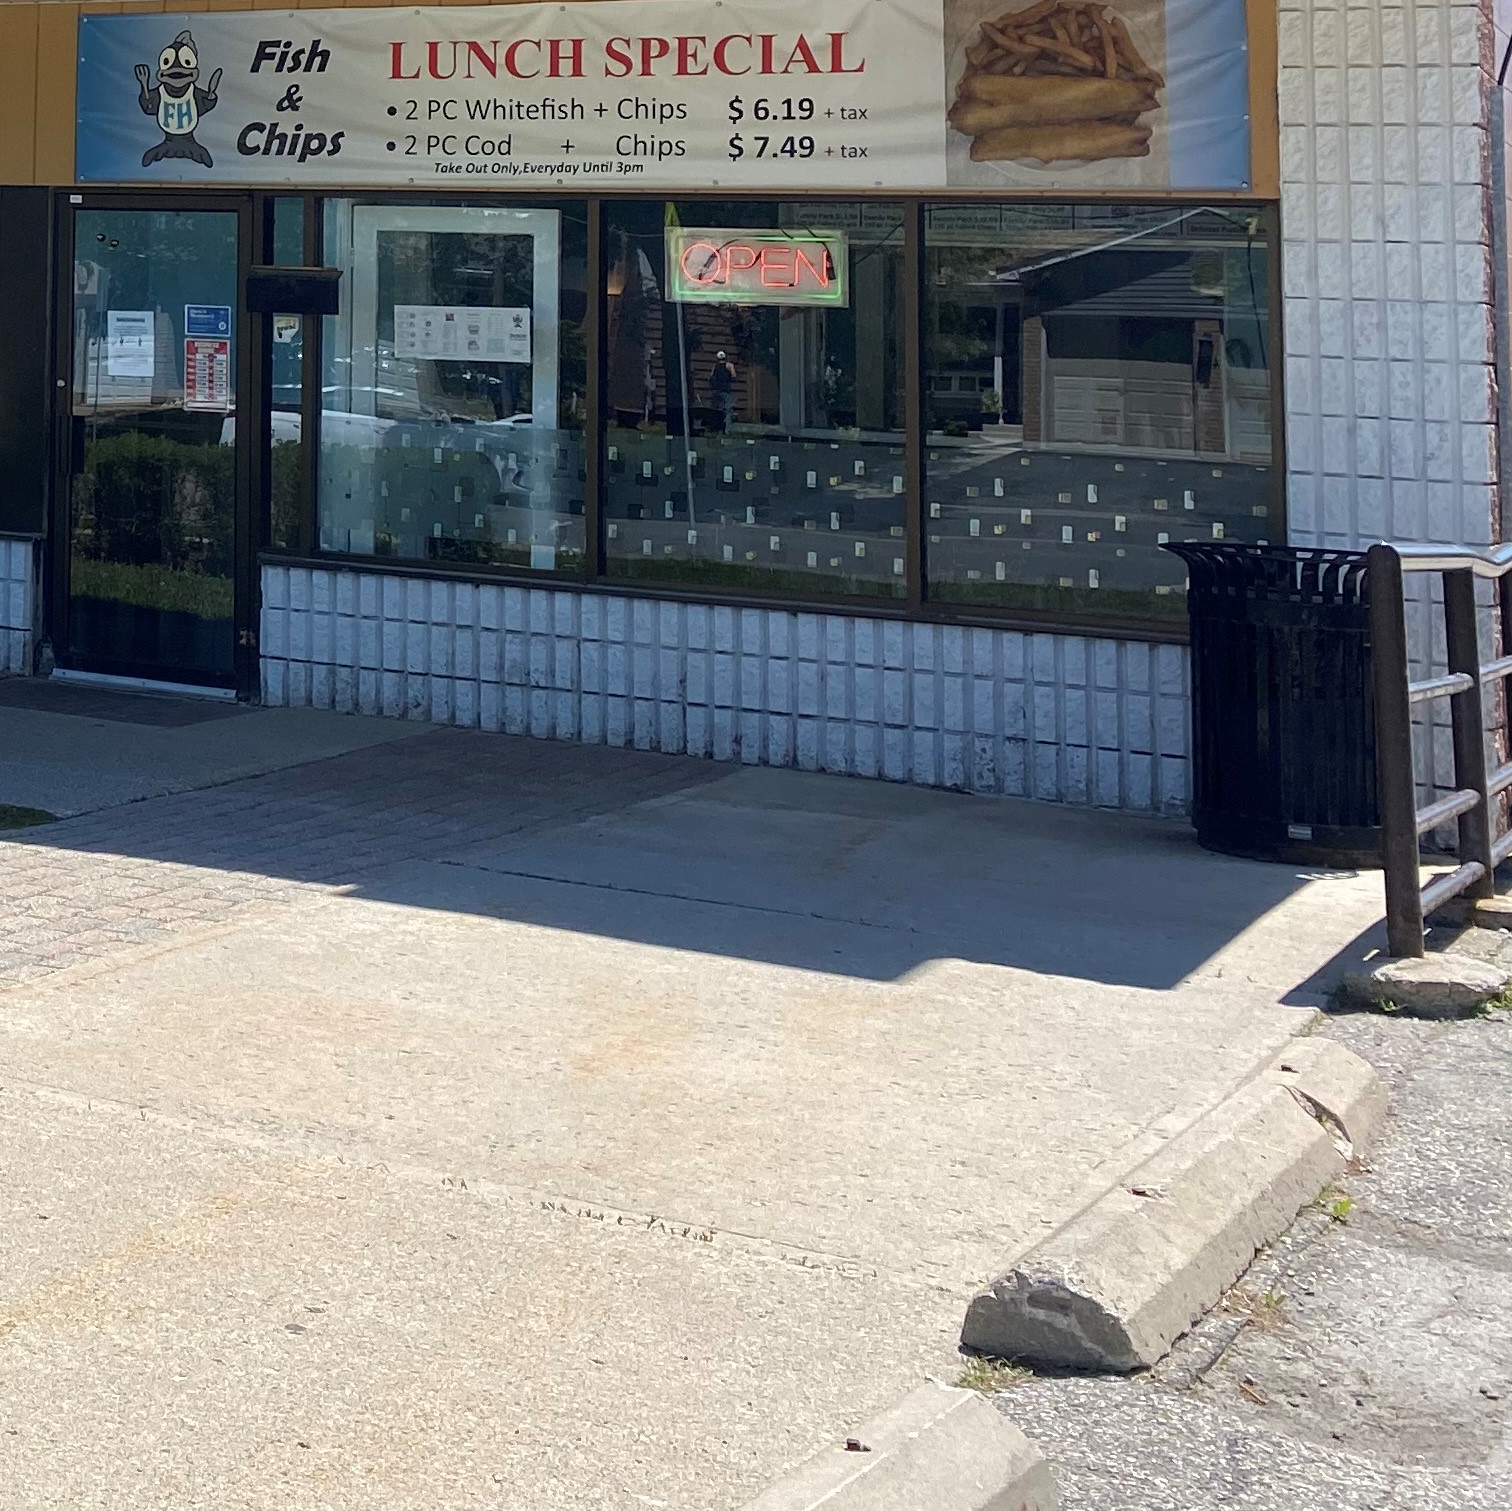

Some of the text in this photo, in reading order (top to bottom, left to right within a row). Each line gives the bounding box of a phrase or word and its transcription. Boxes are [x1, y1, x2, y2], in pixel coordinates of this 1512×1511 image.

[250, 39, 331, 74] Fish
[388, 32, 867, 80] LUNCH SPECIAL
[163, 98, 193, 131] FH
[276, 84, 304, 112] &
[404, 99, 419, 121] 2
[427, 99, 458, 121] PC
[465, 96, 585, 121] Whitefish
[593, 102, 609, 119] +
[617, 96, 688, 125] Chips
[839, 105, 869, 121] tax
[236, 121, 346, 163] Chips
[404, 136, 418, 157] 2
[426, 136, 458, 157] PC
[464, 134, 513, 157] Cod
[560, 138, 576, 155] +
[615, 134, 687, 162] Chips
[839, 143, 869, 159] tax
[434, 162, 463, 174] Take
[465, 162, 488, 174] Out
[583, 161, 614, 173] Until
[615, 162, 644, 176] 3pm
[682, 242, 831, 289] OPEN
